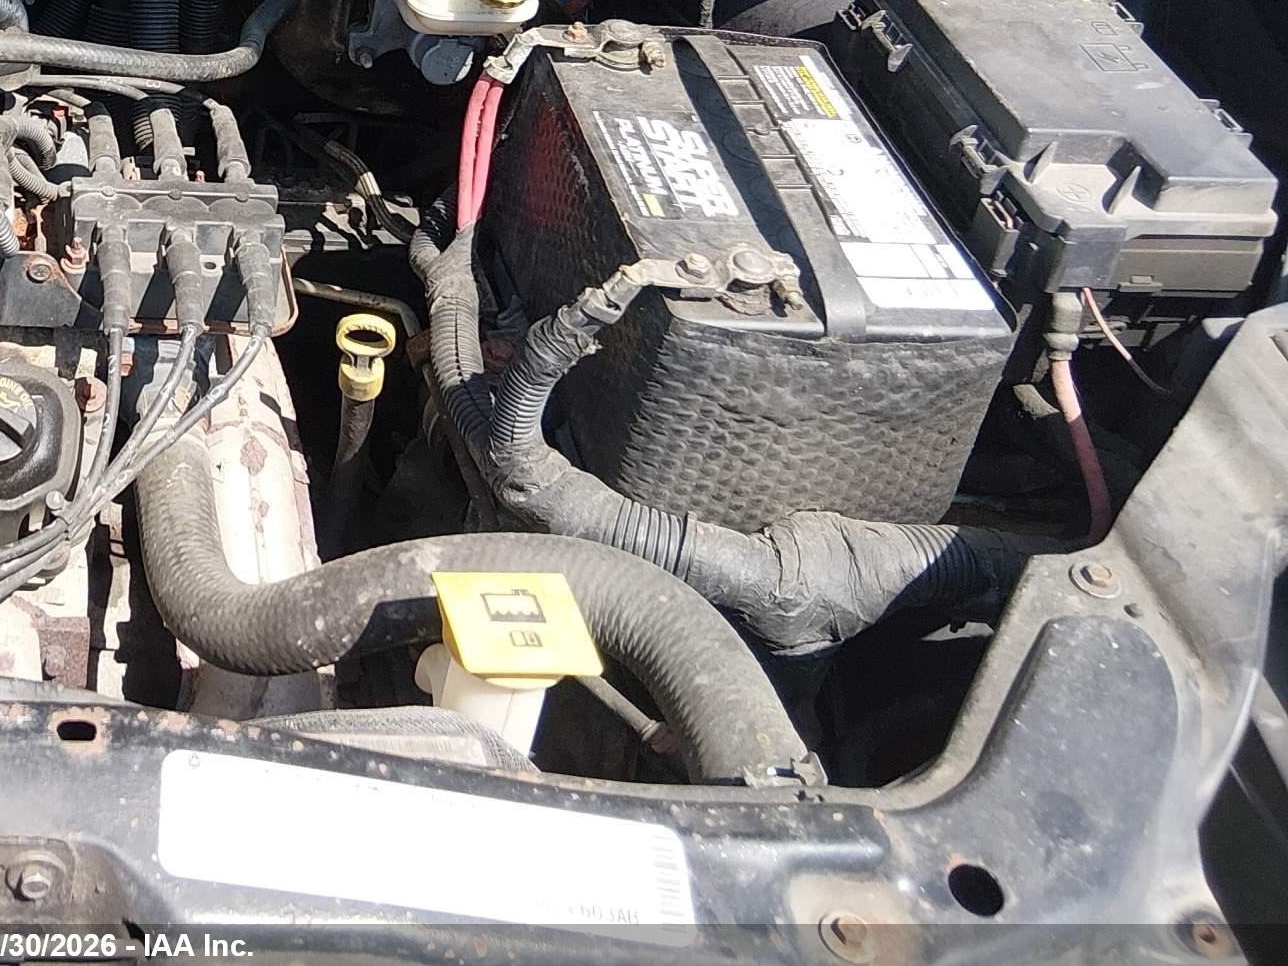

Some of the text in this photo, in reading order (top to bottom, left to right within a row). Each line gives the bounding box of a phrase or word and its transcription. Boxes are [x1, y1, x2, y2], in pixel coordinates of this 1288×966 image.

[614, 117, 668, 196] PLATINUM
[636, 115, 700, 211] START
[680, 130, 739, 217] SUPER
[20, 392, 34, 411] OIL
